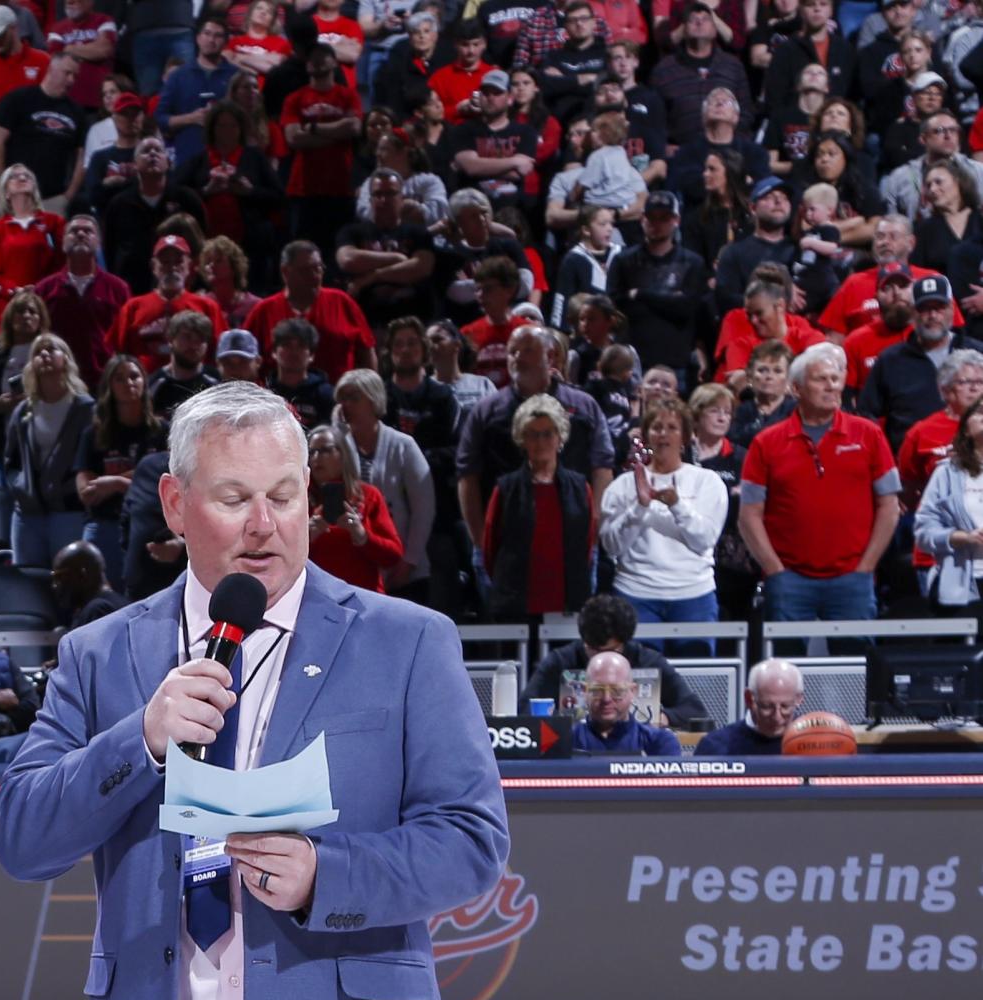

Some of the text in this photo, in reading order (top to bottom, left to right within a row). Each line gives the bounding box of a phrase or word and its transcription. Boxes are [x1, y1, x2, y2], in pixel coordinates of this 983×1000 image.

[609, 762, 682, 775] INDIANA
[699, 762, 746, 774] BOLD
[192, 870, 217, 882] BOARD
[627, 853, 960, 912] Presenting
[680, 923, 844, 972] State
